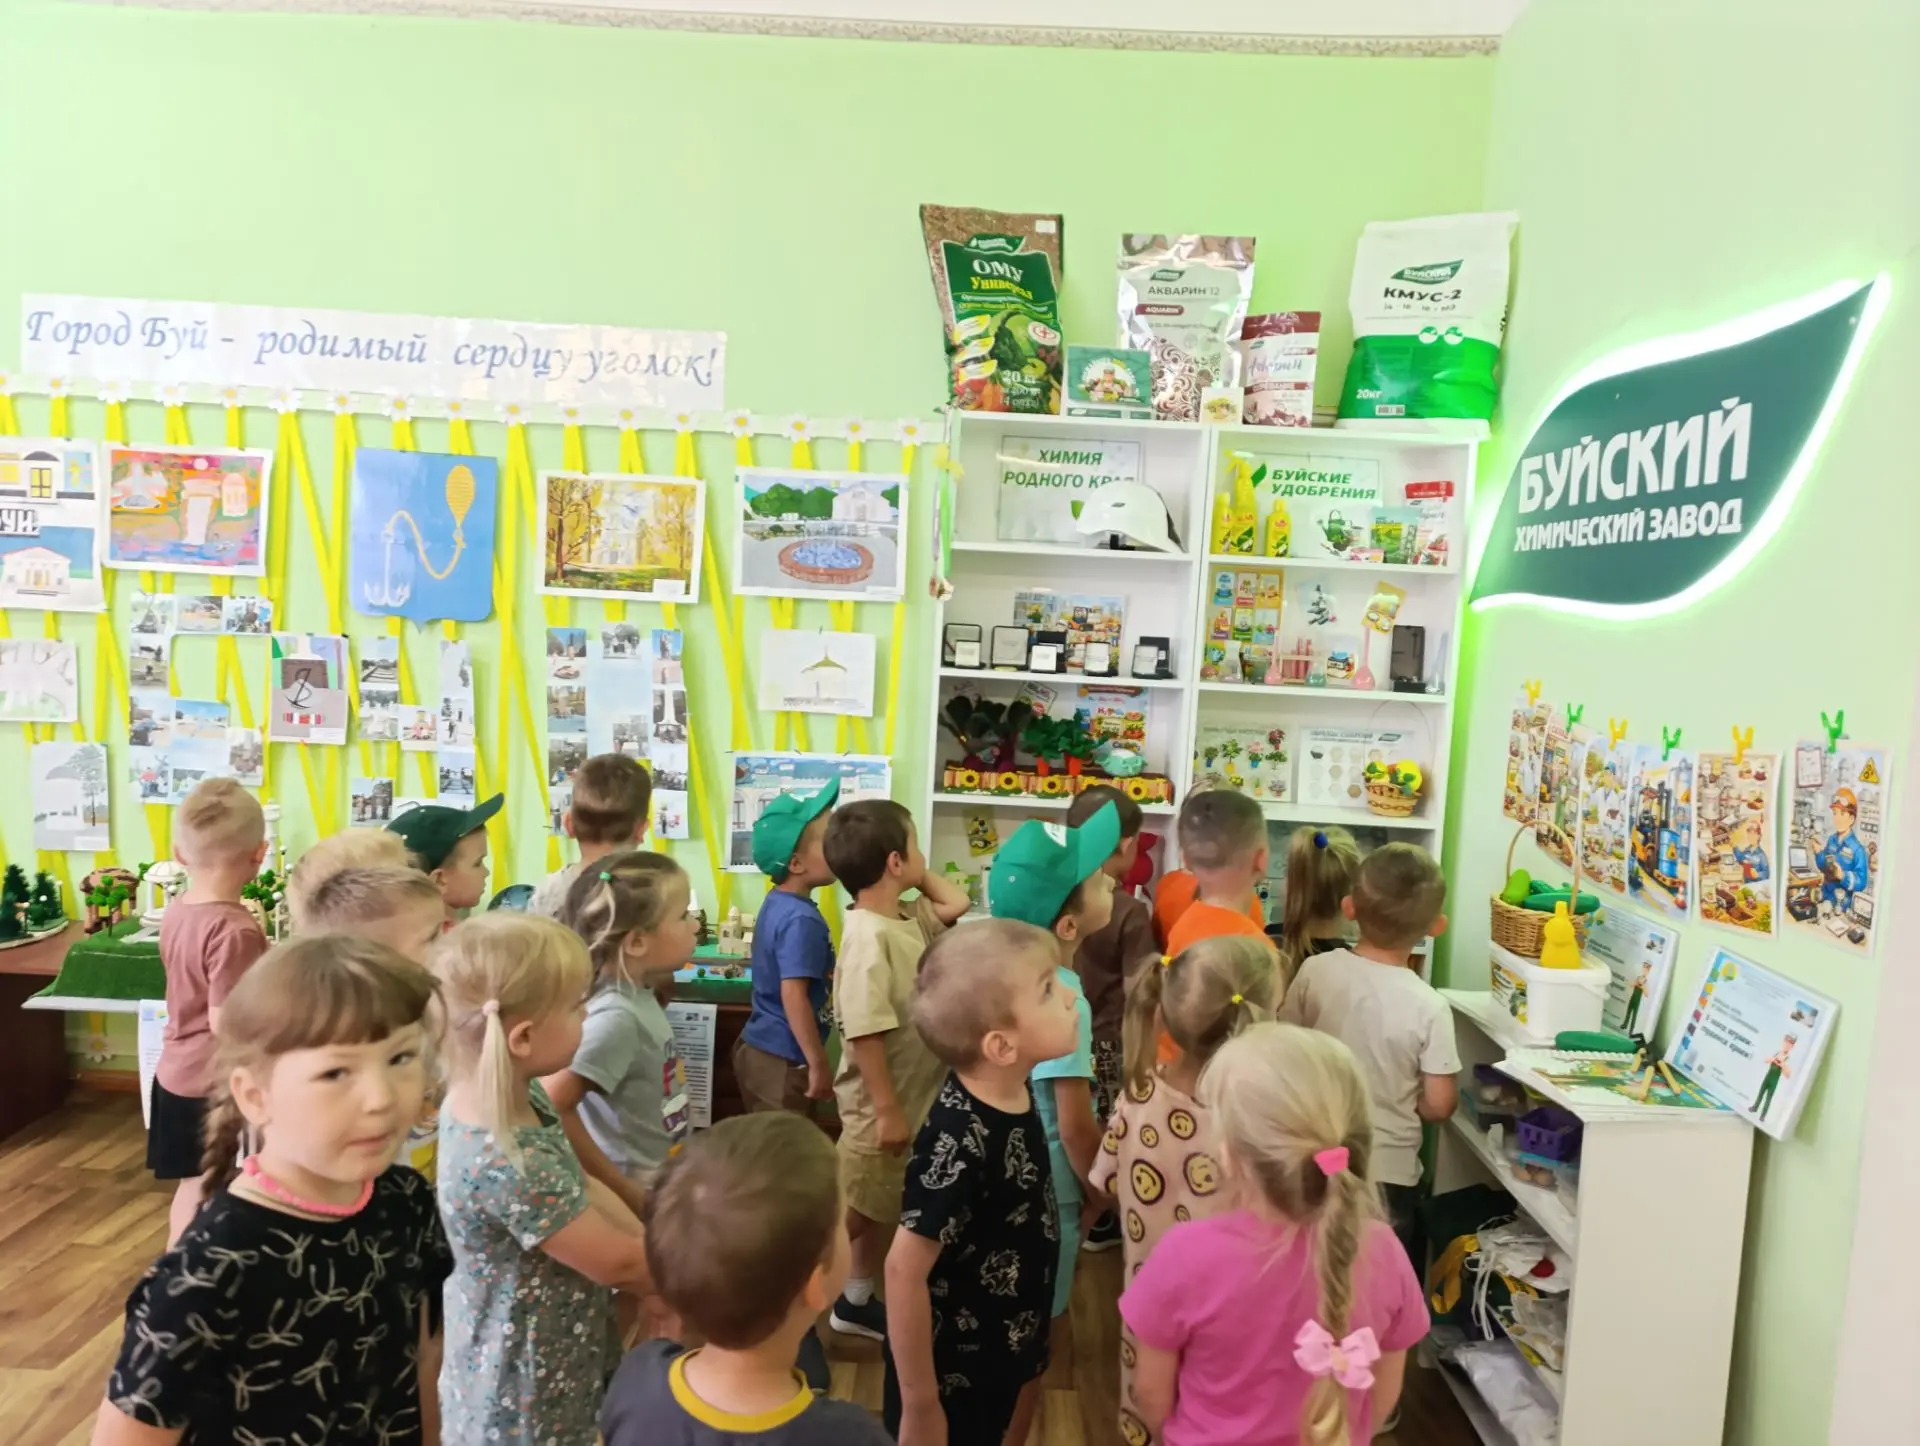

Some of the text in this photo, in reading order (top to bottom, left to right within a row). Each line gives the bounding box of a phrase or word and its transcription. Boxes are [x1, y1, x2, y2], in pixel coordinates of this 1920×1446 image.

[973, 259, 1023, 283] ОМУ
[1148, 286, 1206, 296] АКВАРИН
[1383, 286, 1462, 302] КМУС-2
[26, 310, 132, 355] Город
[140, 316, 209, 359] Буй
[254, 319, 428, 365] родимый
[453, 332, 574, 381] сердцу
[580, 347, 717, 387] уголок!
[1356, 387, 1382, 399] 20кг
[1038, 449, 1103, 466] ХИМИЯ
[1518, 396, 1752, 515] БУЙСКИЙ
[1003, 471, 1134, 489] РОДНОГО КР
[1272, 467, 1352, 485] БУЙСКИЕ
[1271, 483, 1376, 500] УДОБРЕНИЯ
[1514, 498, 1743, 552] ХИМИЧЕСКИЙ ЗАВОД
